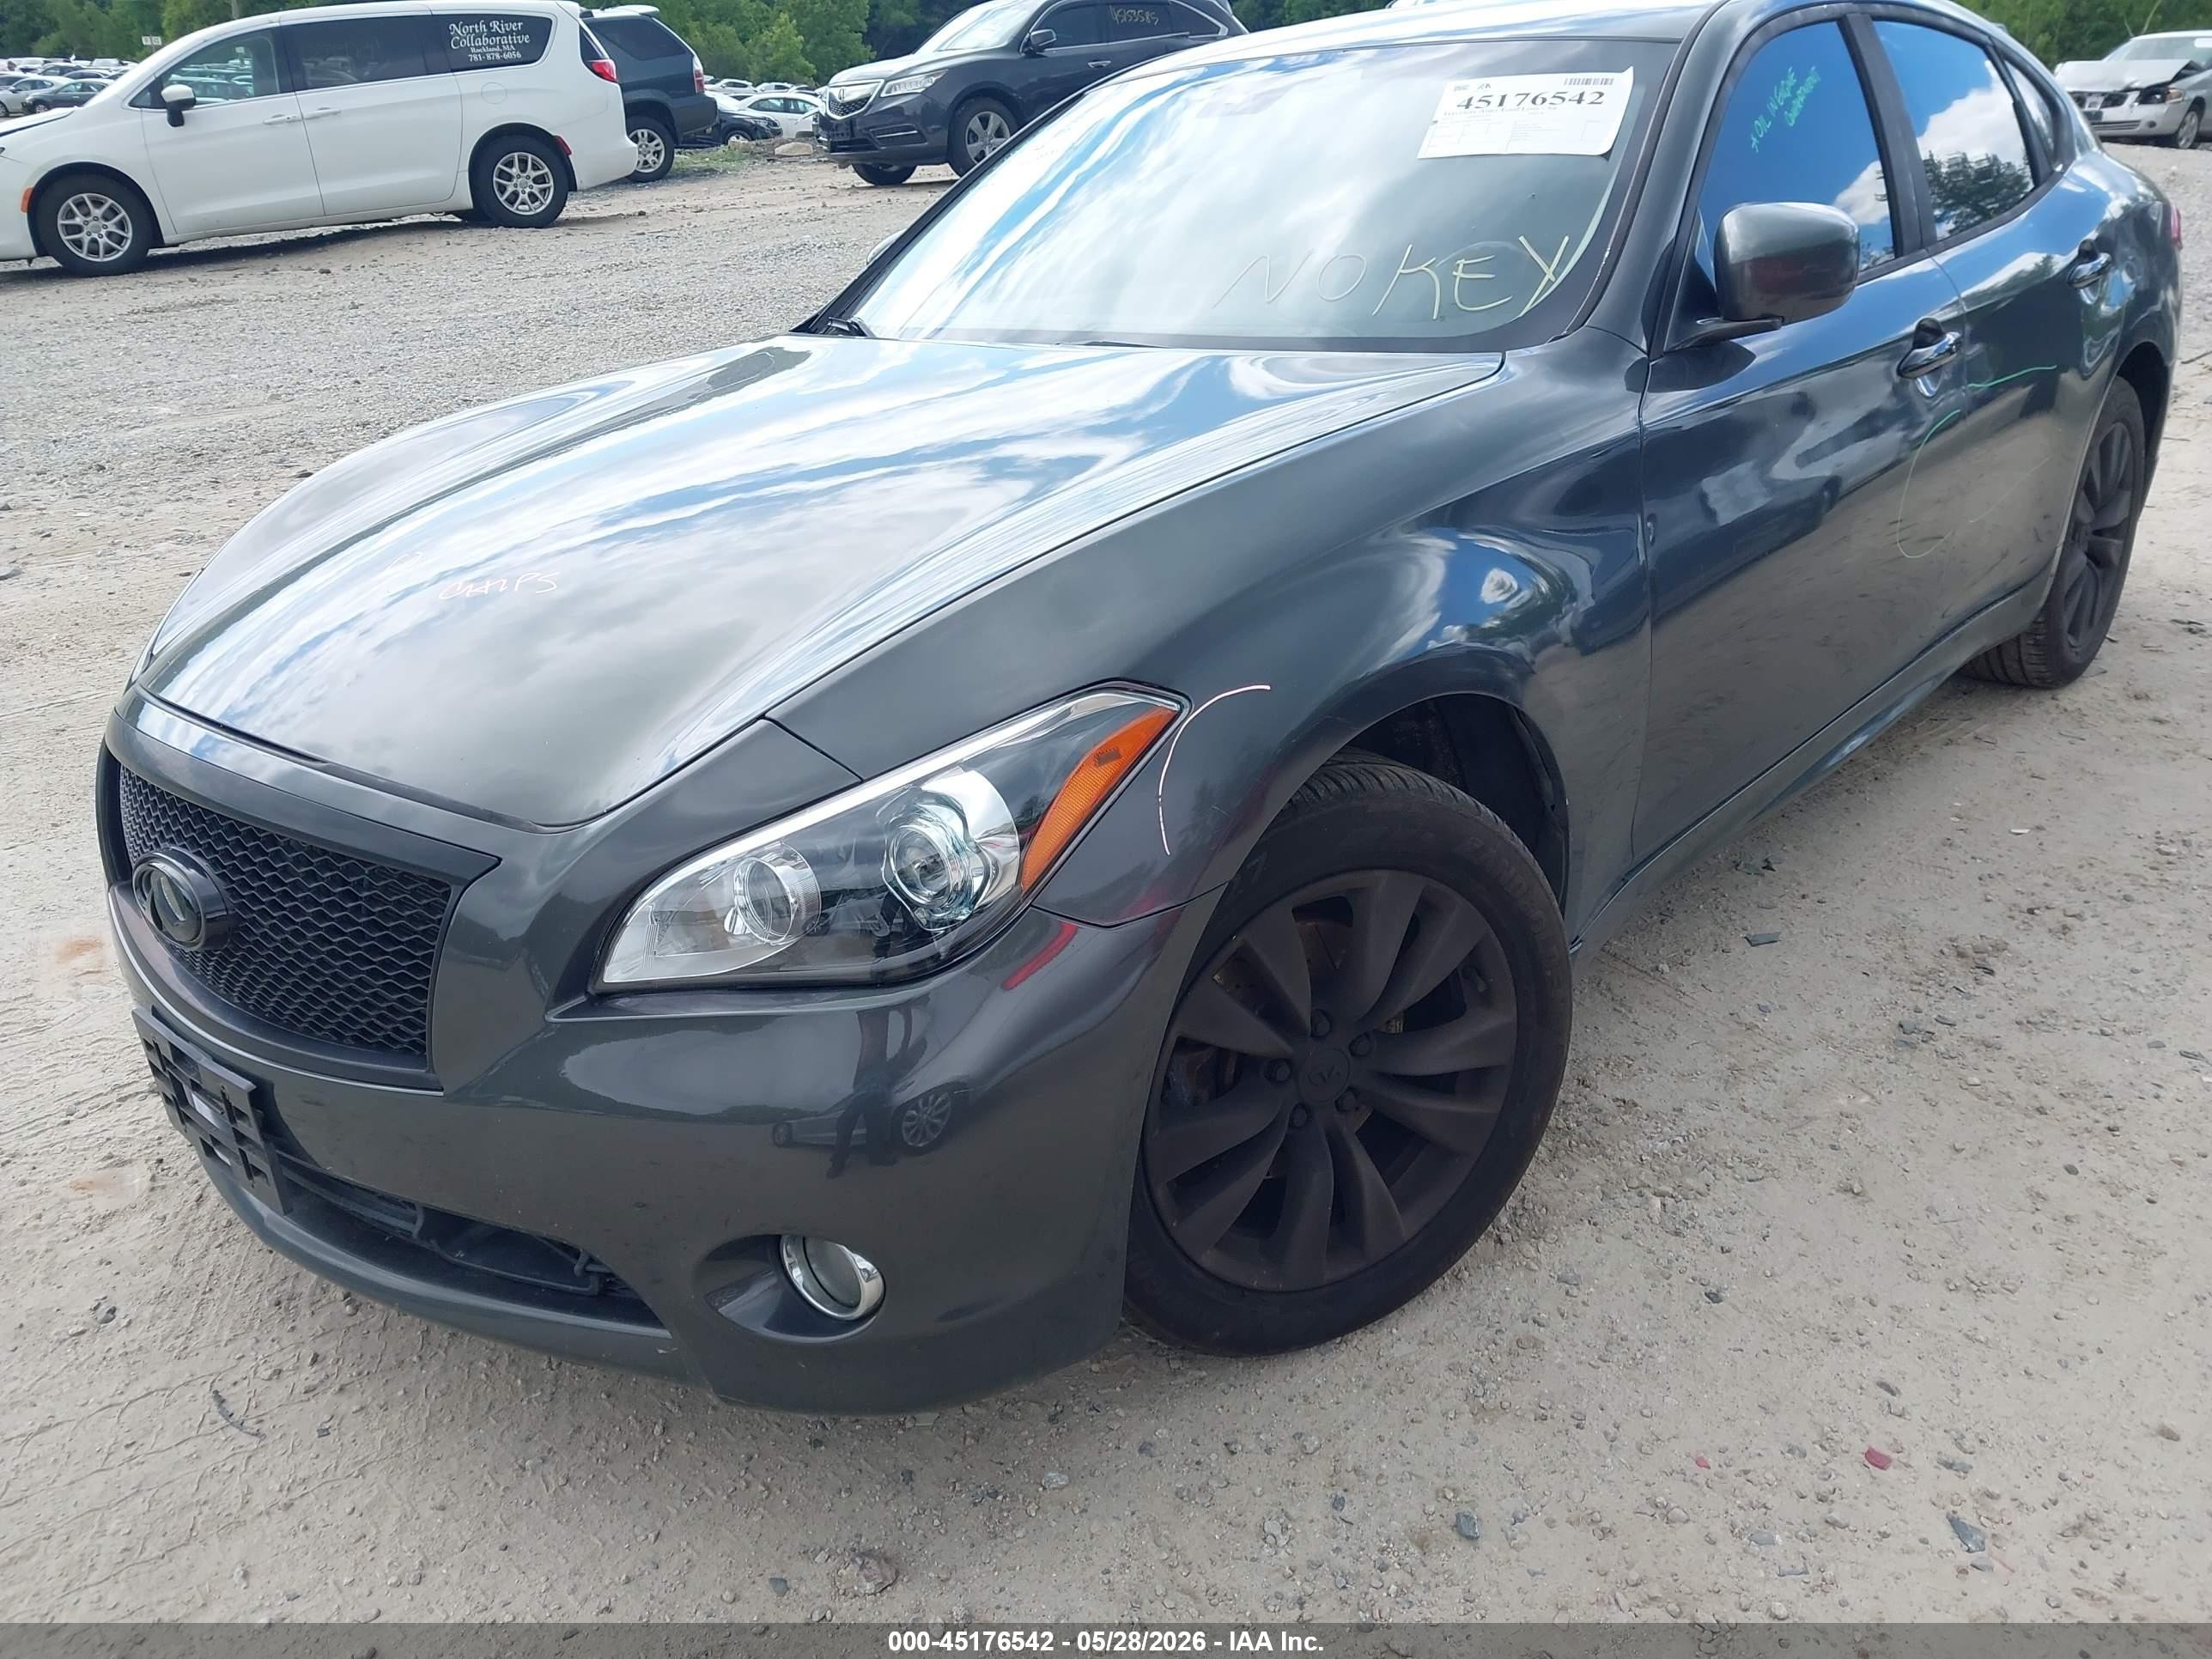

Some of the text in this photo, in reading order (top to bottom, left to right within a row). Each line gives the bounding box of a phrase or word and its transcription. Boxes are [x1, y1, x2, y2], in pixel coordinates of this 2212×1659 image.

[449, 20, 523, 36] North River
[451, 33, 531, 49] Collaborative
[468, 52, 522, 62] 781-878-6056
[1456, 91, 1605, 110] 45176542
[1212, 235, 1569, 320] NO KEY
